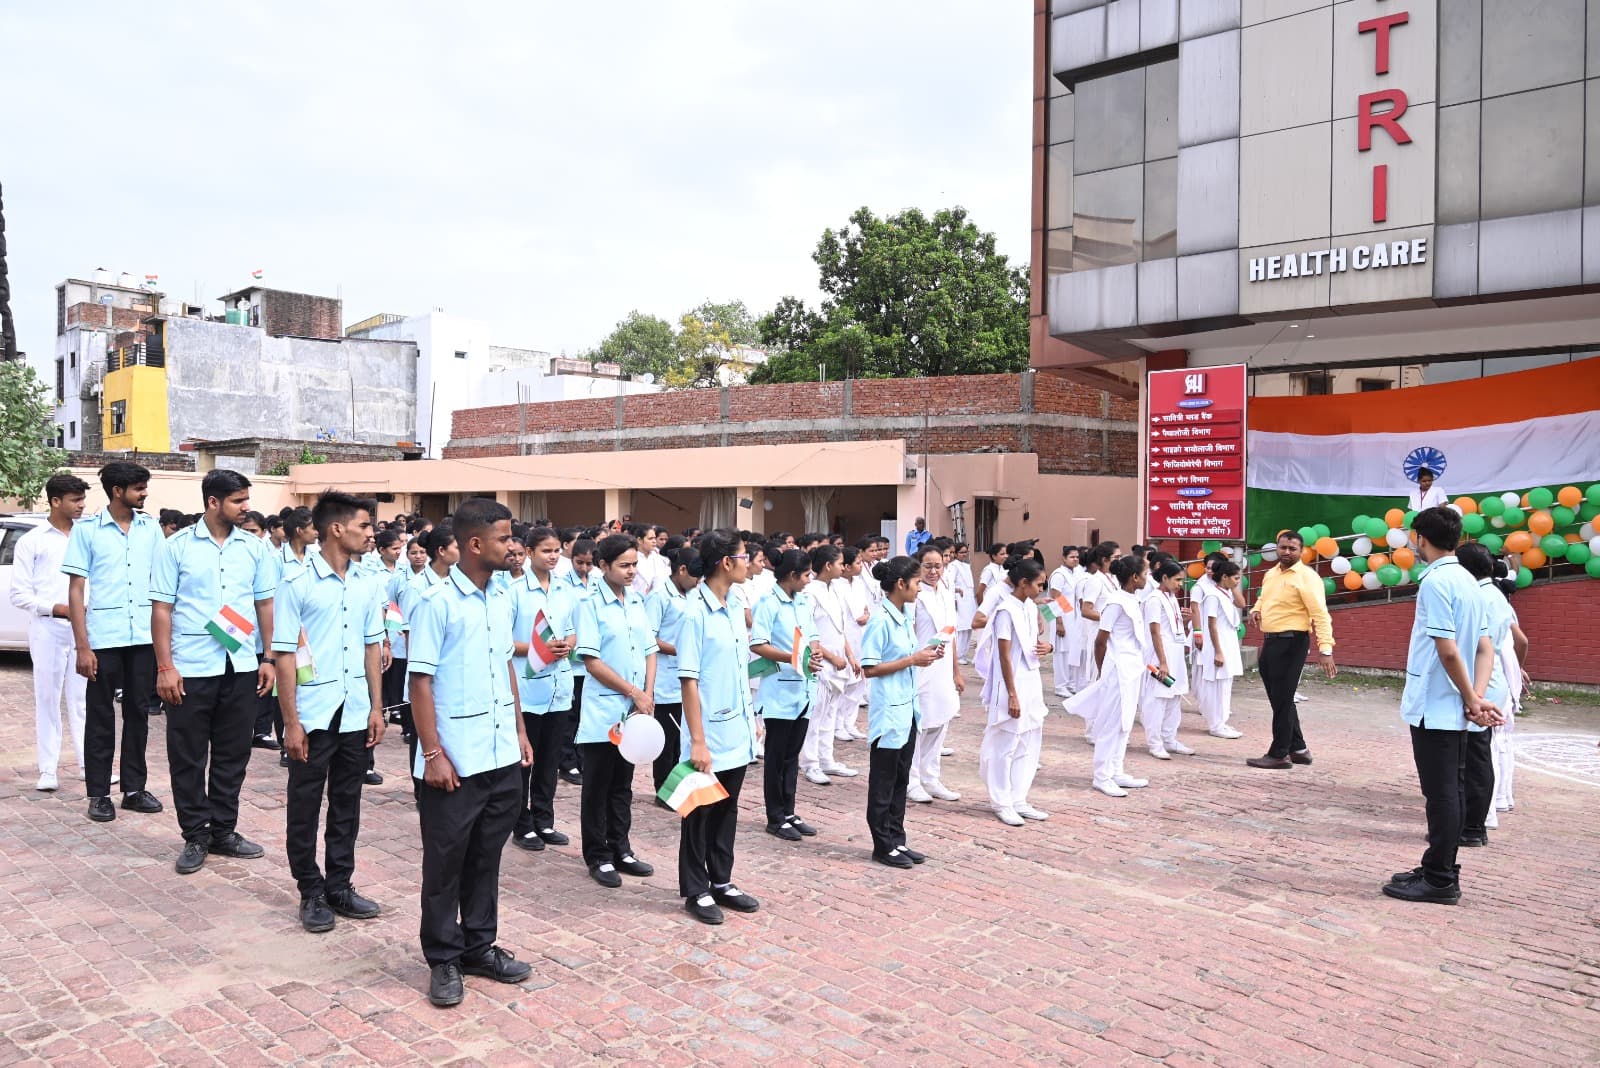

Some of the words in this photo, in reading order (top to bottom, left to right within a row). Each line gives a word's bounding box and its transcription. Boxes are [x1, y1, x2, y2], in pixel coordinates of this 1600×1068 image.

[1358, 0, 1412, 223] TRI
[1192, 427, 1211, 436] विभाग
[1215, 443, 1235, 452] विभाग
[1204, 458, 1223, 468] विभाग
[1190, 474, 1209, 483] विभाग
[1169, 500, 1194, 511] सावित्री
